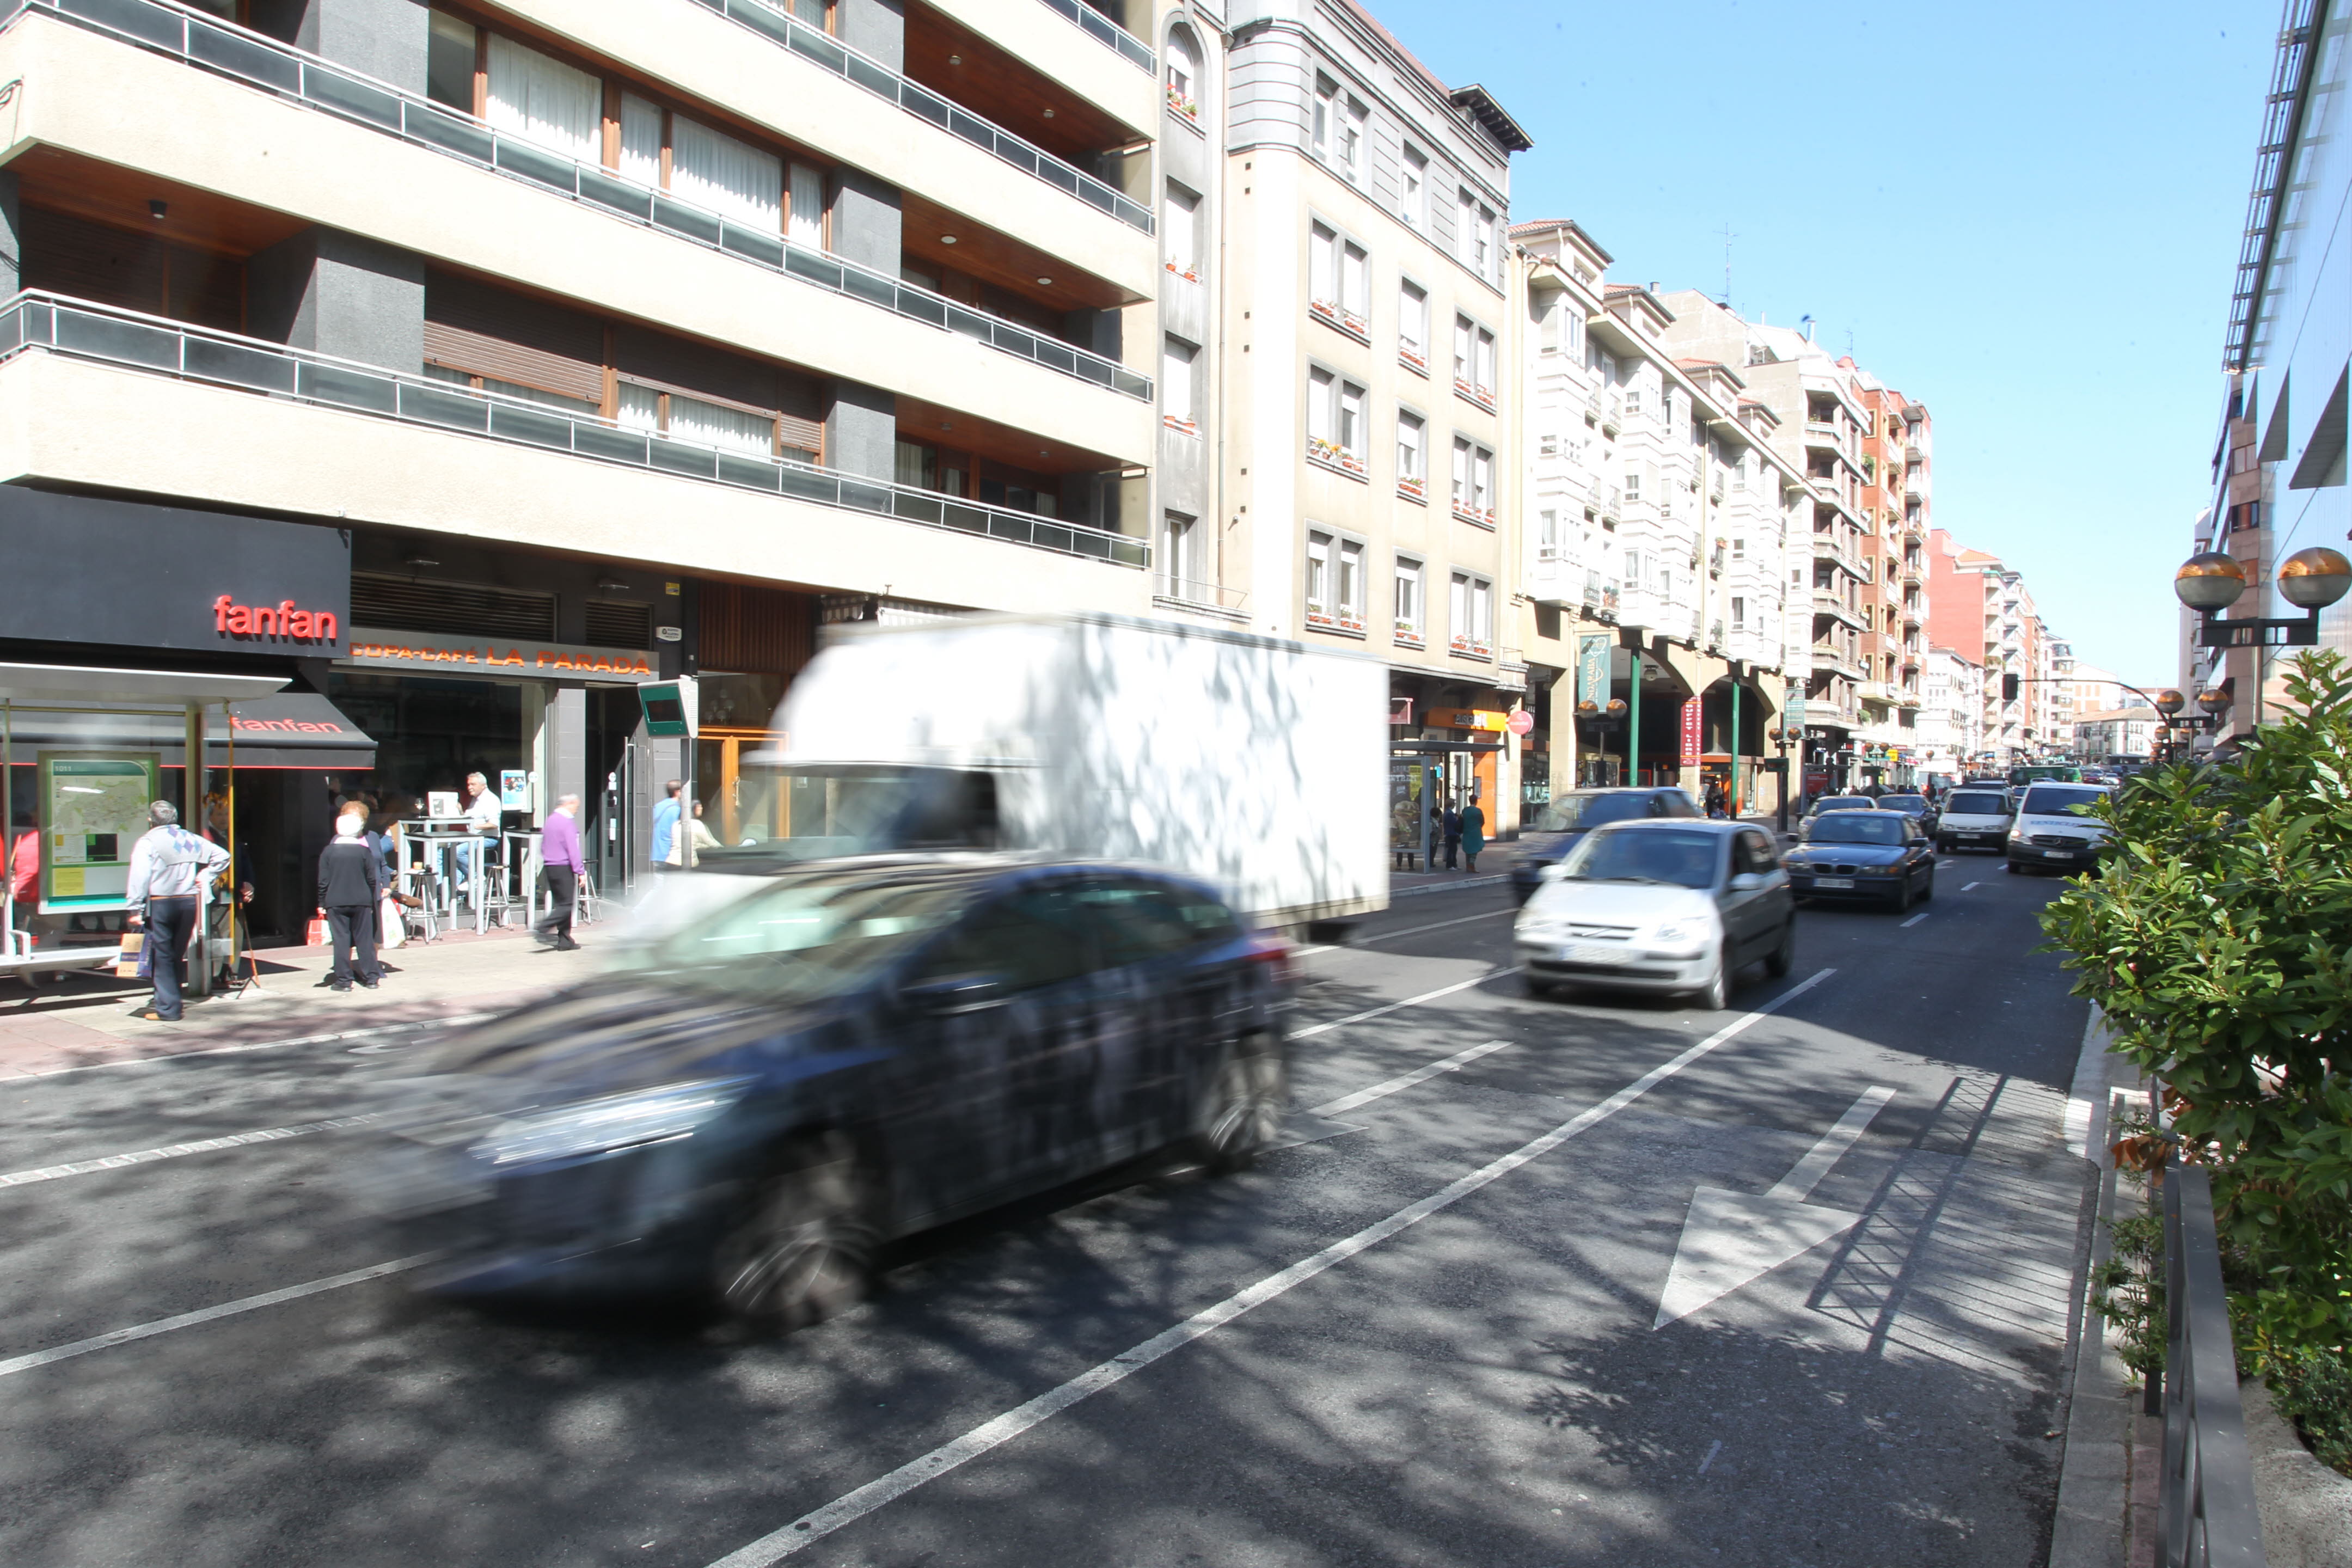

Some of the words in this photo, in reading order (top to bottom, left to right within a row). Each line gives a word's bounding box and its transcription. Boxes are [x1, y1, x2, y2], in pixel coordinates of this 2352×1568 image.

[213, 594, 337, 639] fanfan
[349, 642, 479, 664] COPA-CAFÉ
[486, 646, 525, 667] LA
[536, 650, 651, 676] PARADA
[227, 716, 344, 733] fanfan
